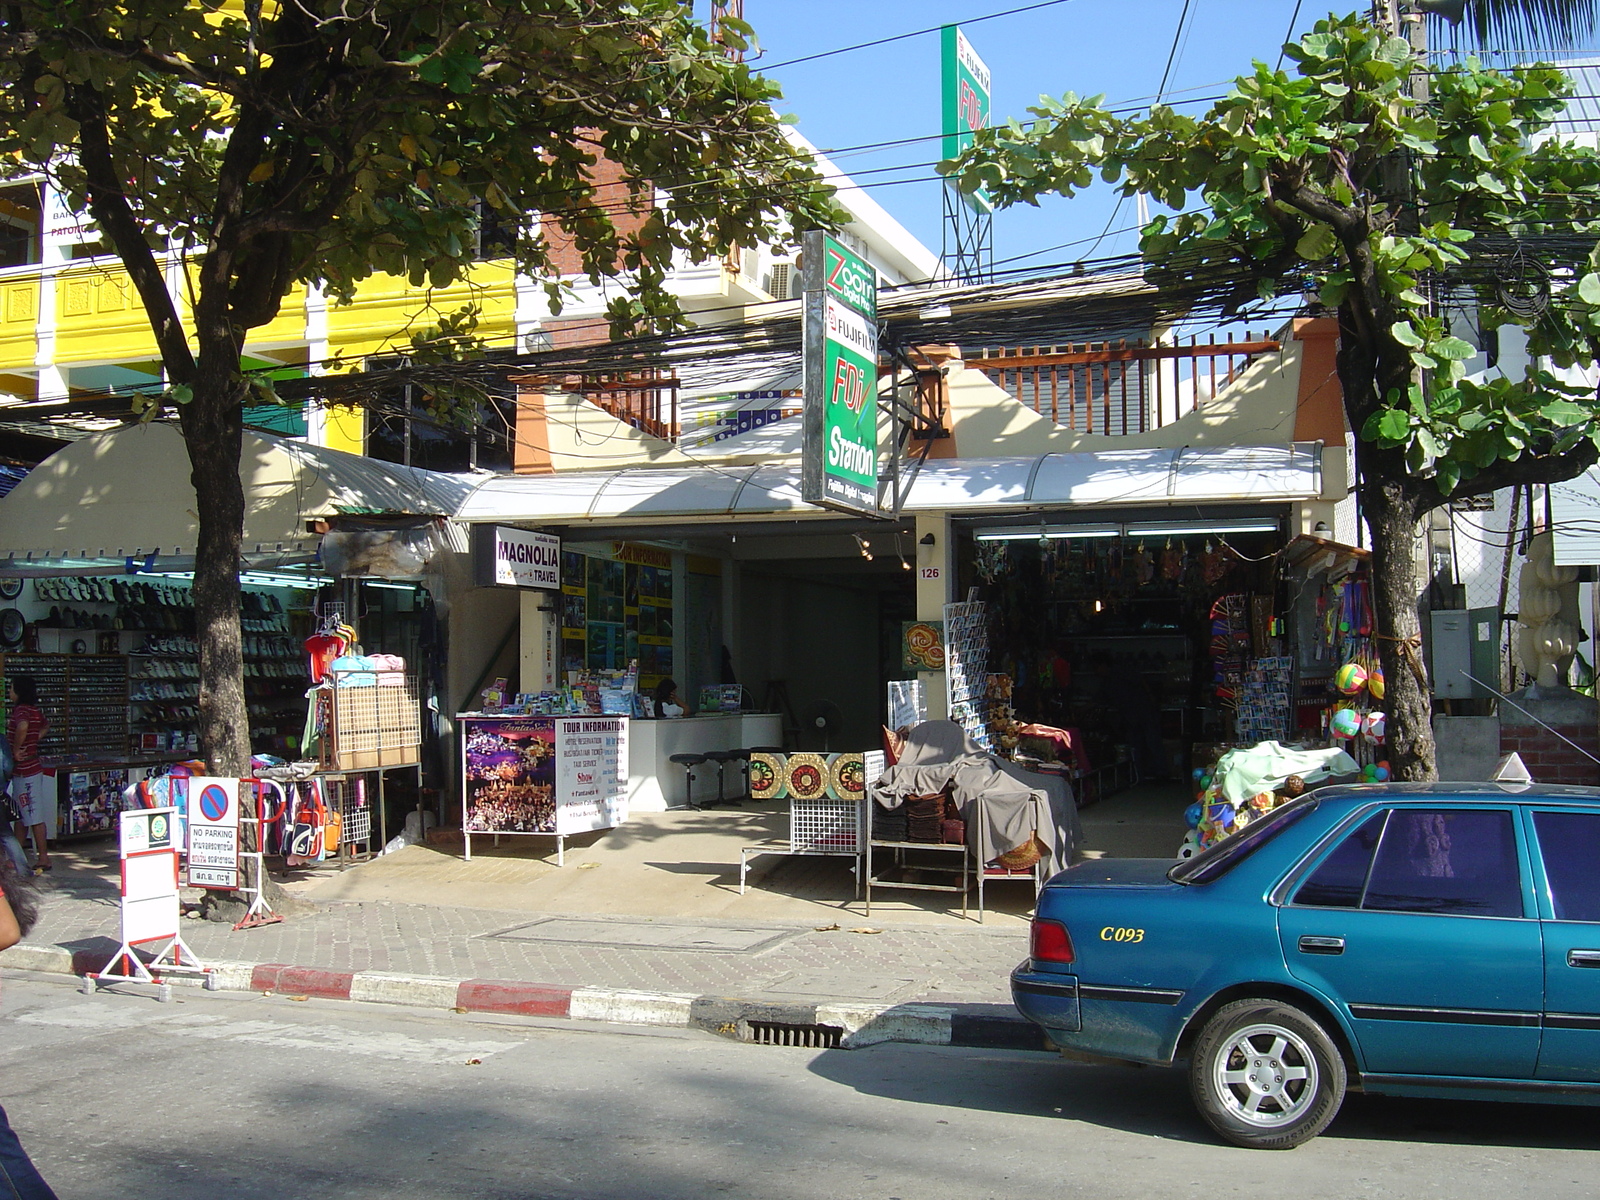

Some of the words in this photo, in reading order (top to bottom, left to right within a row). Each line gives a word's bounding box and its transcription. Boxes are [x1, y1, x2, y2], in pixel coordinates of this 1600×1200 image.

[966, 51, 990, 94] FUJIFILM
[827, 247, 875, 303] Zoom
[843, 284, 860, 304] Digital
[838, 318, 876, 355] FUJIFILM
[498, 541, 558, 568] MAGNOLIA
[534, 569, 557, 583] TRAVEL
[921, 568, 939, 578] 126
[563, 722, 581, 733] TOUR
[582, 721, 625, 732] INFORMATION
[578, 737, 602, 745] RESERVATION
[582, 760, 597, 768] SERVICE
[577, 772, 592, 783] Show
[193, 828, 203, 837] NO
[205, 829, 233, 838] PARKING
